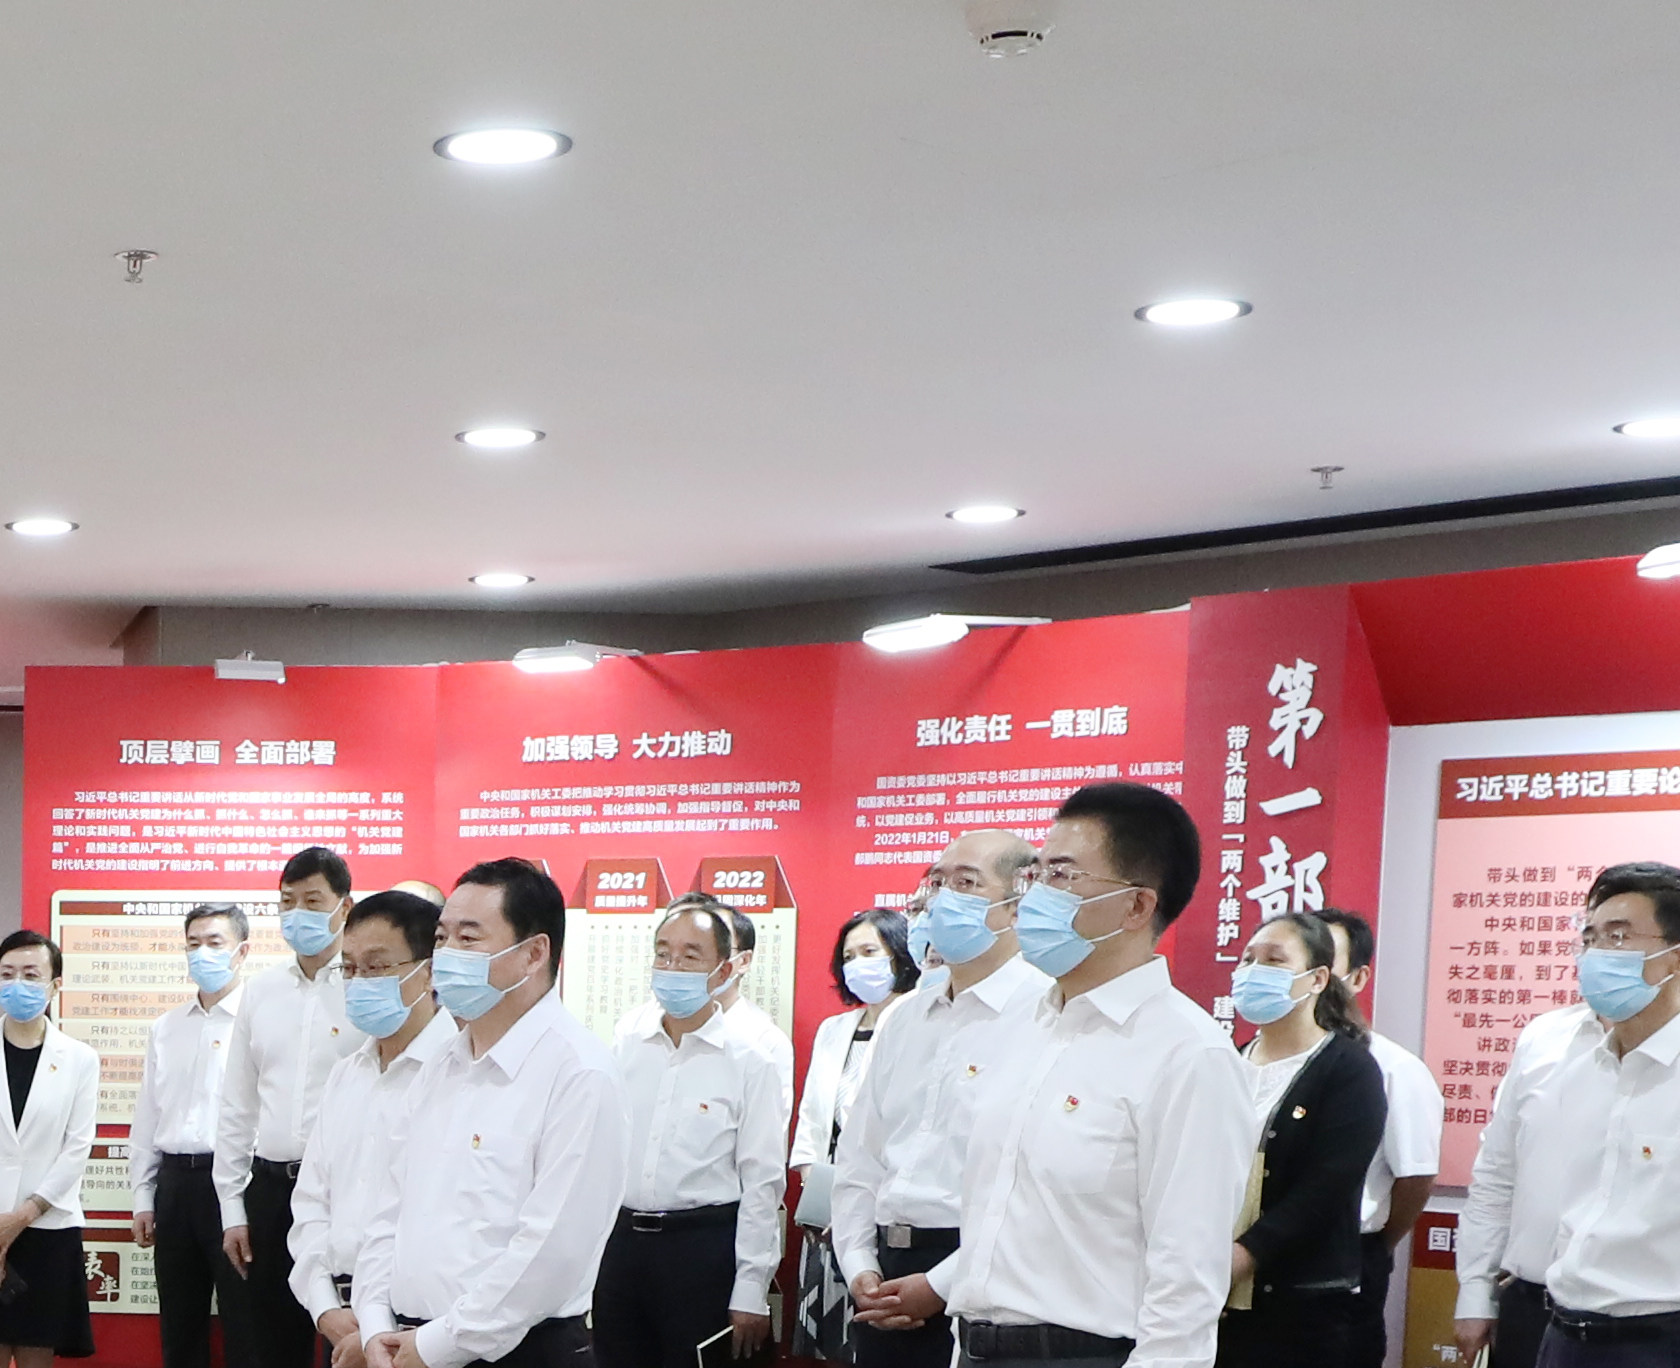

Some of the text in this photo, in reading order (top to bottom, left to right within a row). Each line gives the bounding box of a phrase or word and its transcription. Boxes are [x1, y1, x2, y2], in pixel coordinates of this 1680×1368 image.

[915, 704, 1129, 748] 强化责任 一贯到底
[118, 738, 337, 766] 顶层擘画 全面部署
[521, 728, 733, 763] 加强领导 大力推动
[596, 871, 648, 890] 2021
[712, 870, 766, 888] 2022
[593, 894, 649, 908] 质量提升年
[1442, 1059, 1508, 1077] 坚决贯彻
